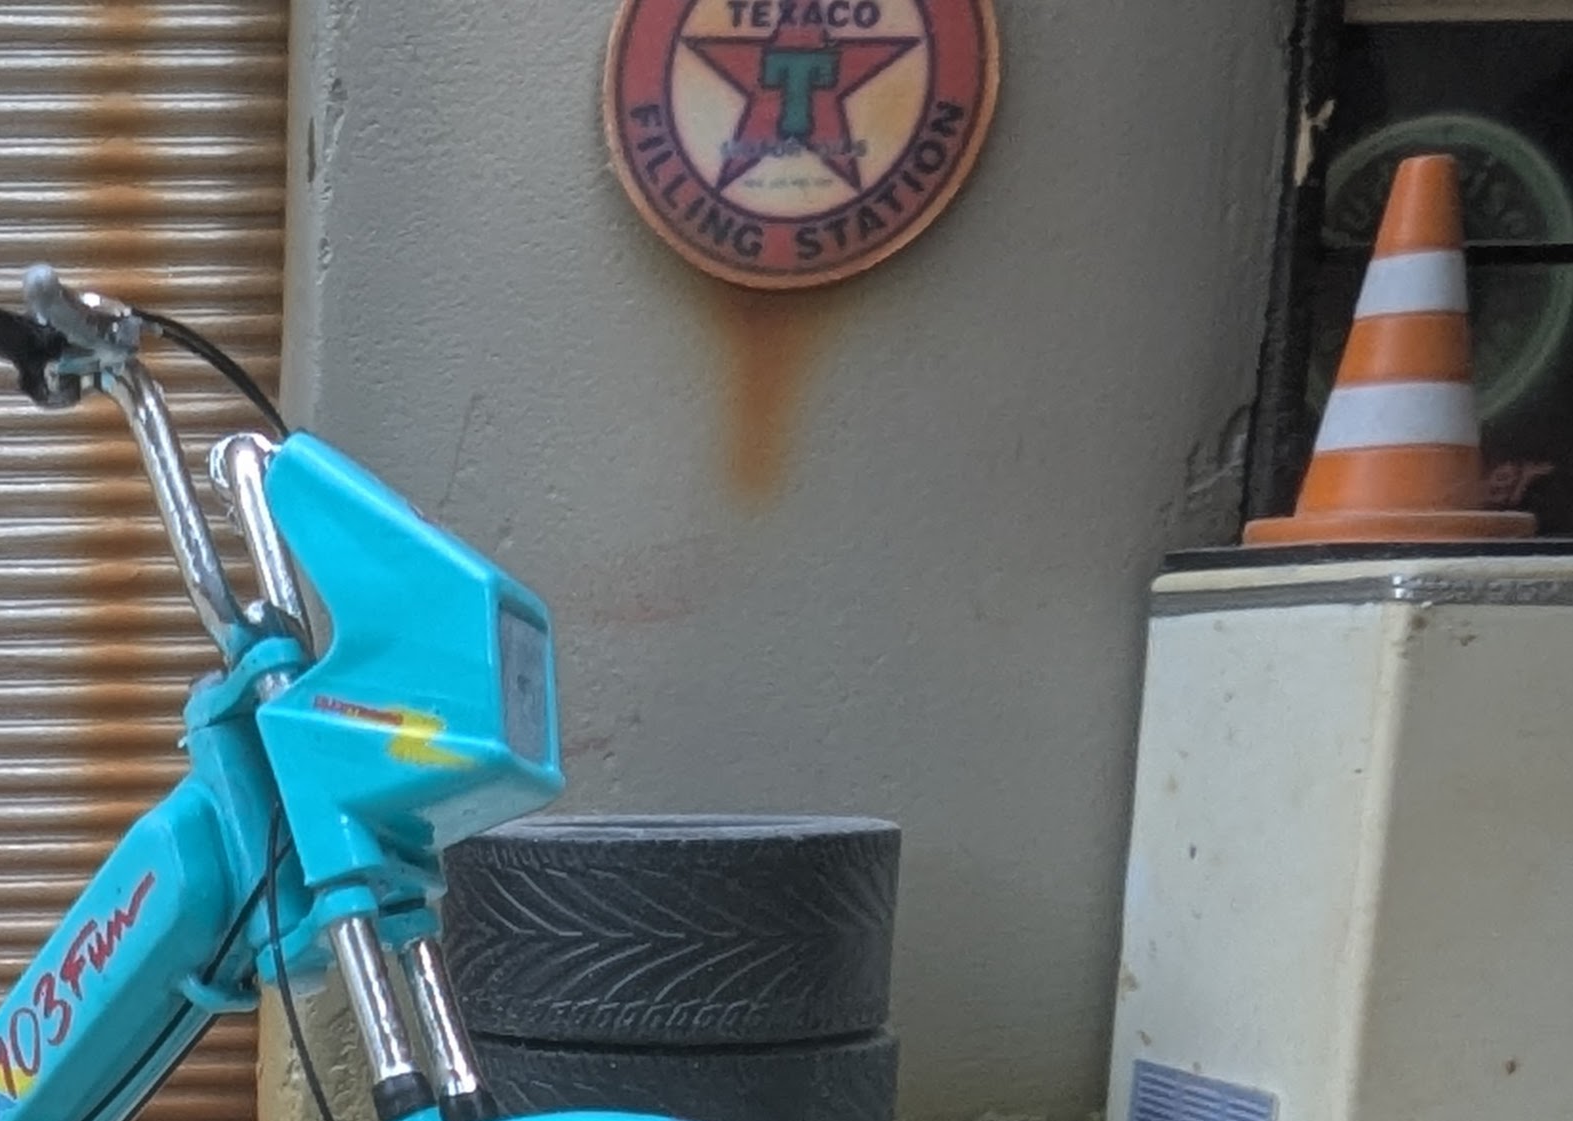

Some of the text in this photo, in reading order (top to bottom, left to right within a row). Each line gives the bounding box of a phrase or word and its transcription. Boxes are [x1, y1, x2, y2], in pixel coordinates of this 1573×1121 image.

[727, 0, 881, 28] TEXACO
[630, 100, 965, 261] FILLING STATION
